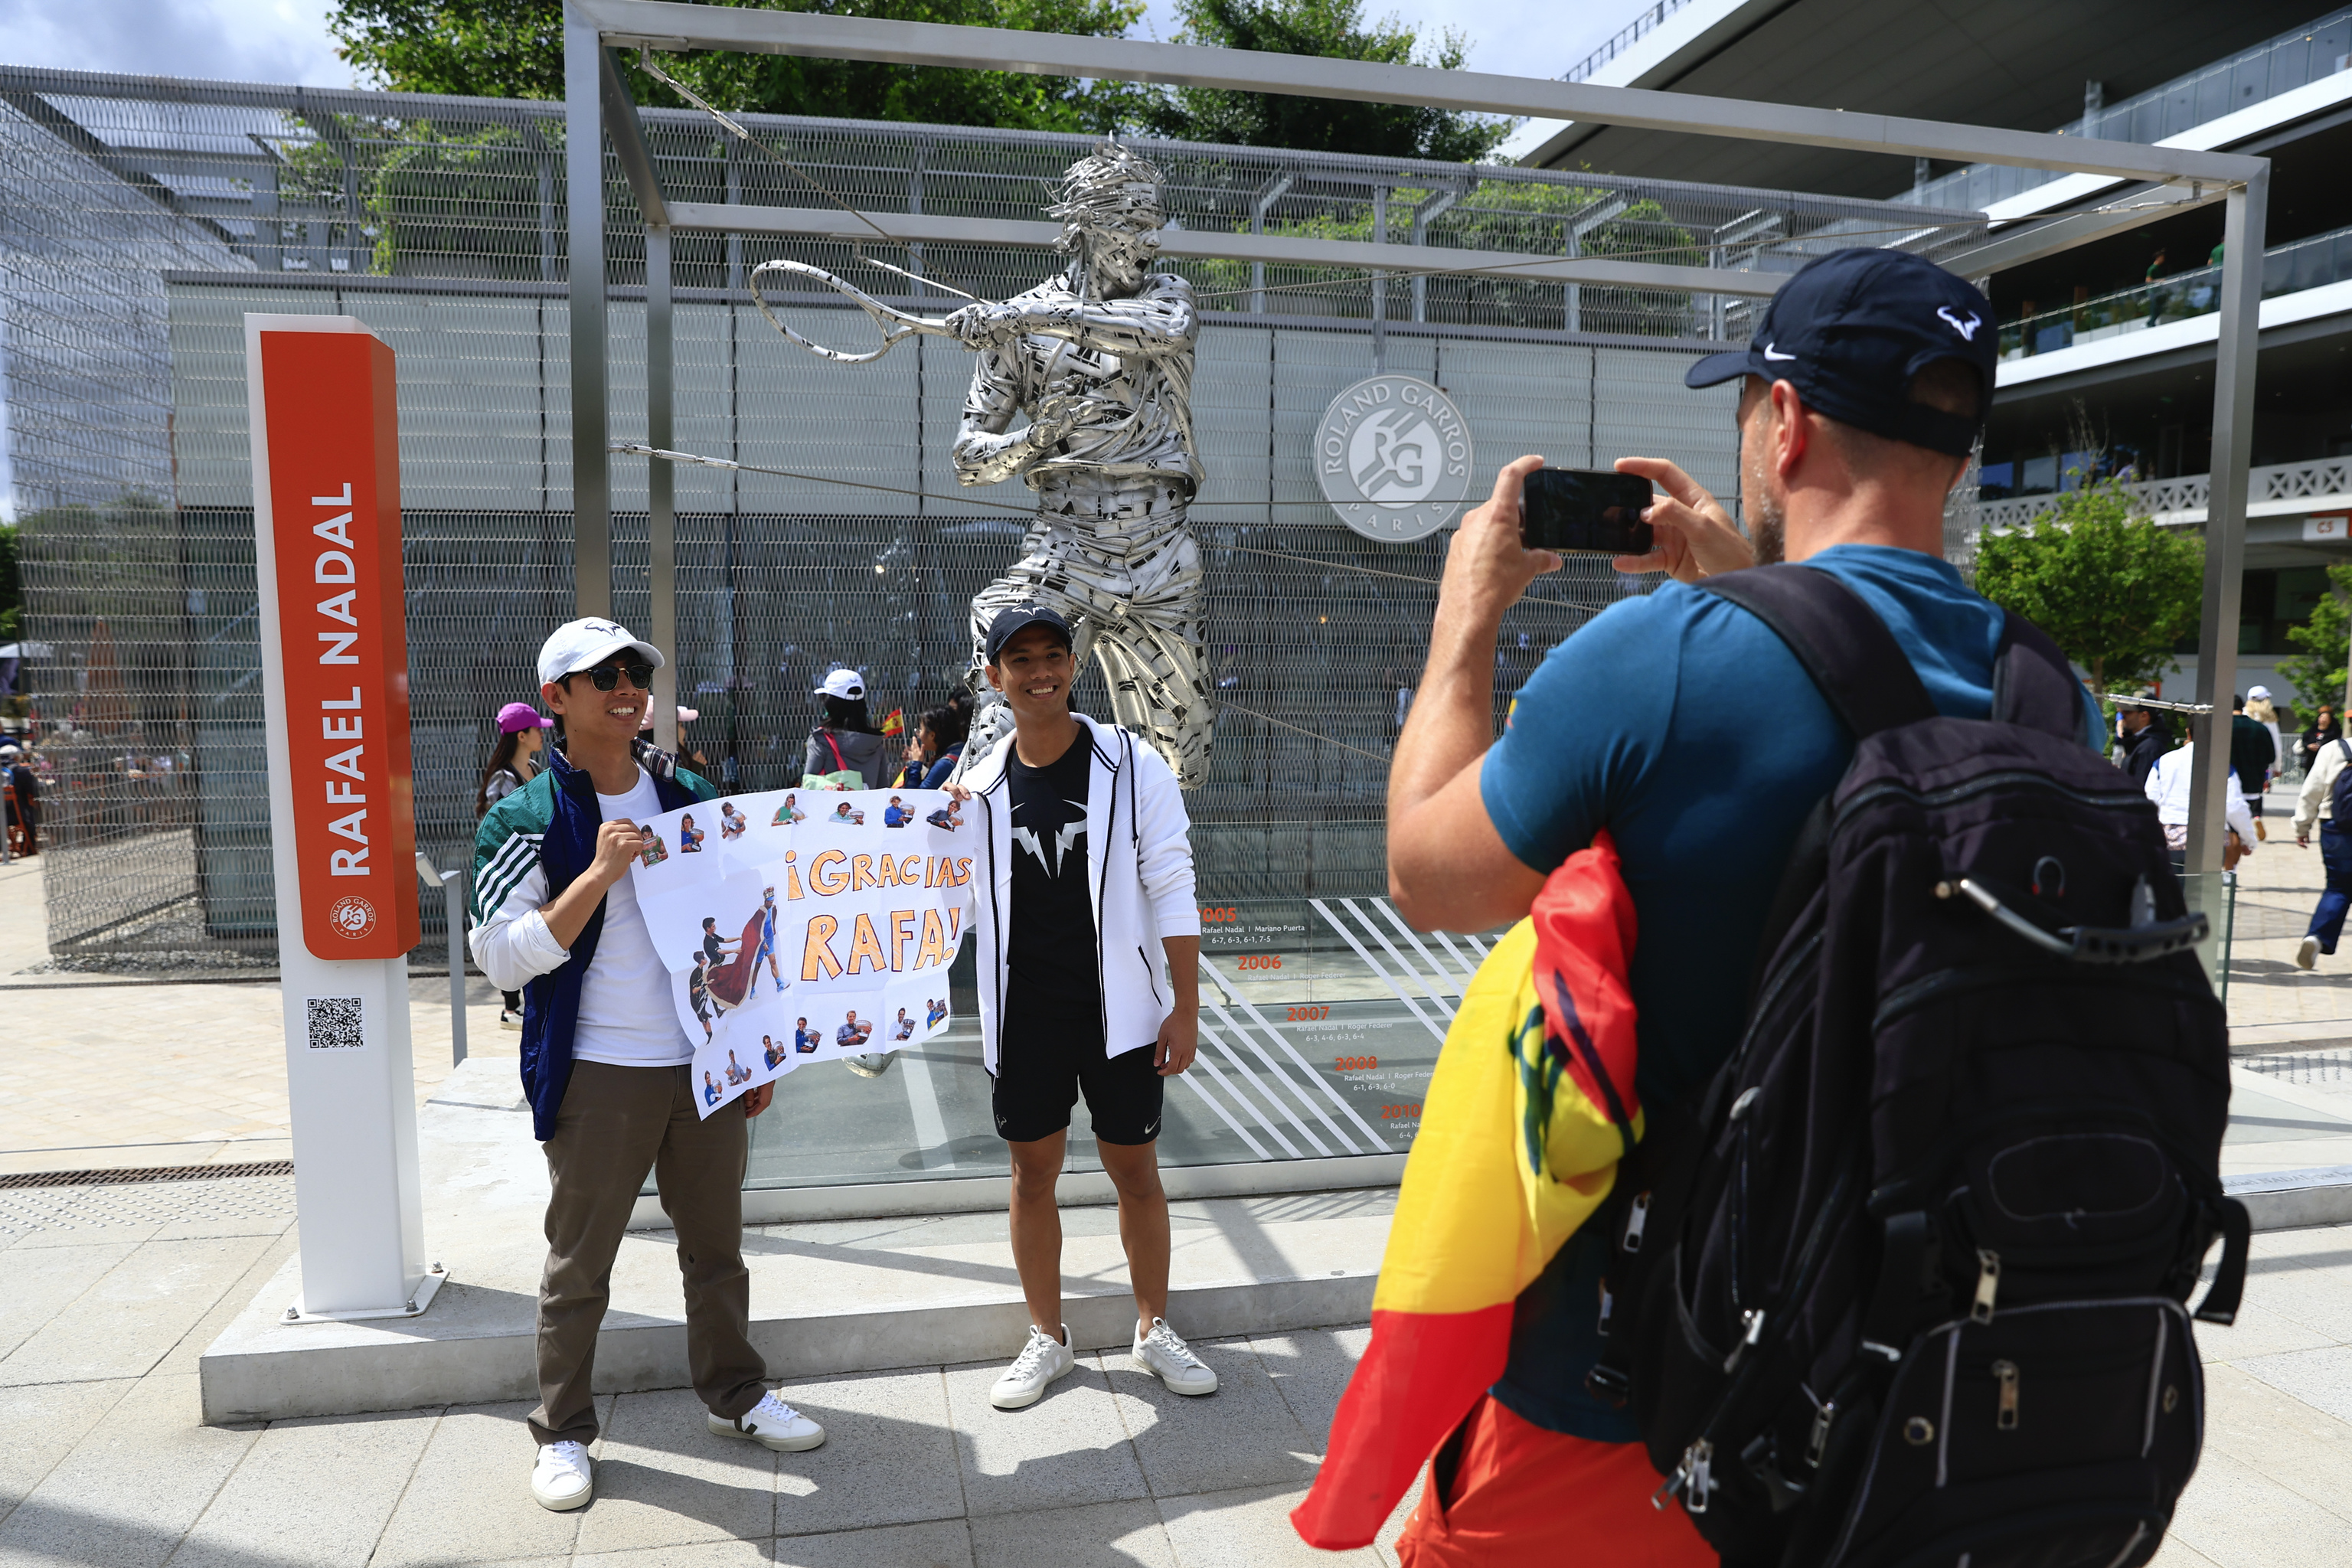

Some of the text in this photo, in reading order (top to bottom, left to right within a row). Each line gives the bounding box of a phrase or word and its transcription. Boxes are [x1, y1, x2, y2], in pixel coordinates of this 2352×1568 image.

[1324, 383, 1466, 477] ROLAND GARROS
[1360, 431, 1423, 496] RG
[1347, 500, 1443, 531] PARIS
[312, 482, 371, 876] RAFAEL NADAL
[332, 898, 374, 923] ROLAND GARROS
[340, 928, 368, 936] PARIS
[801, 907, 960, 982] RAFA!
[1238, 956, 1282, 970] 2006
[1287, 1006, 1330, 1021] 2007
[1348, 1023, 1367, 1031] Roger
[1335, 1056, 1377, 1071] 2008
[1394, 1072, 1413, 1080] Roger
[1381, 1104, 1421, 1119] 2010
